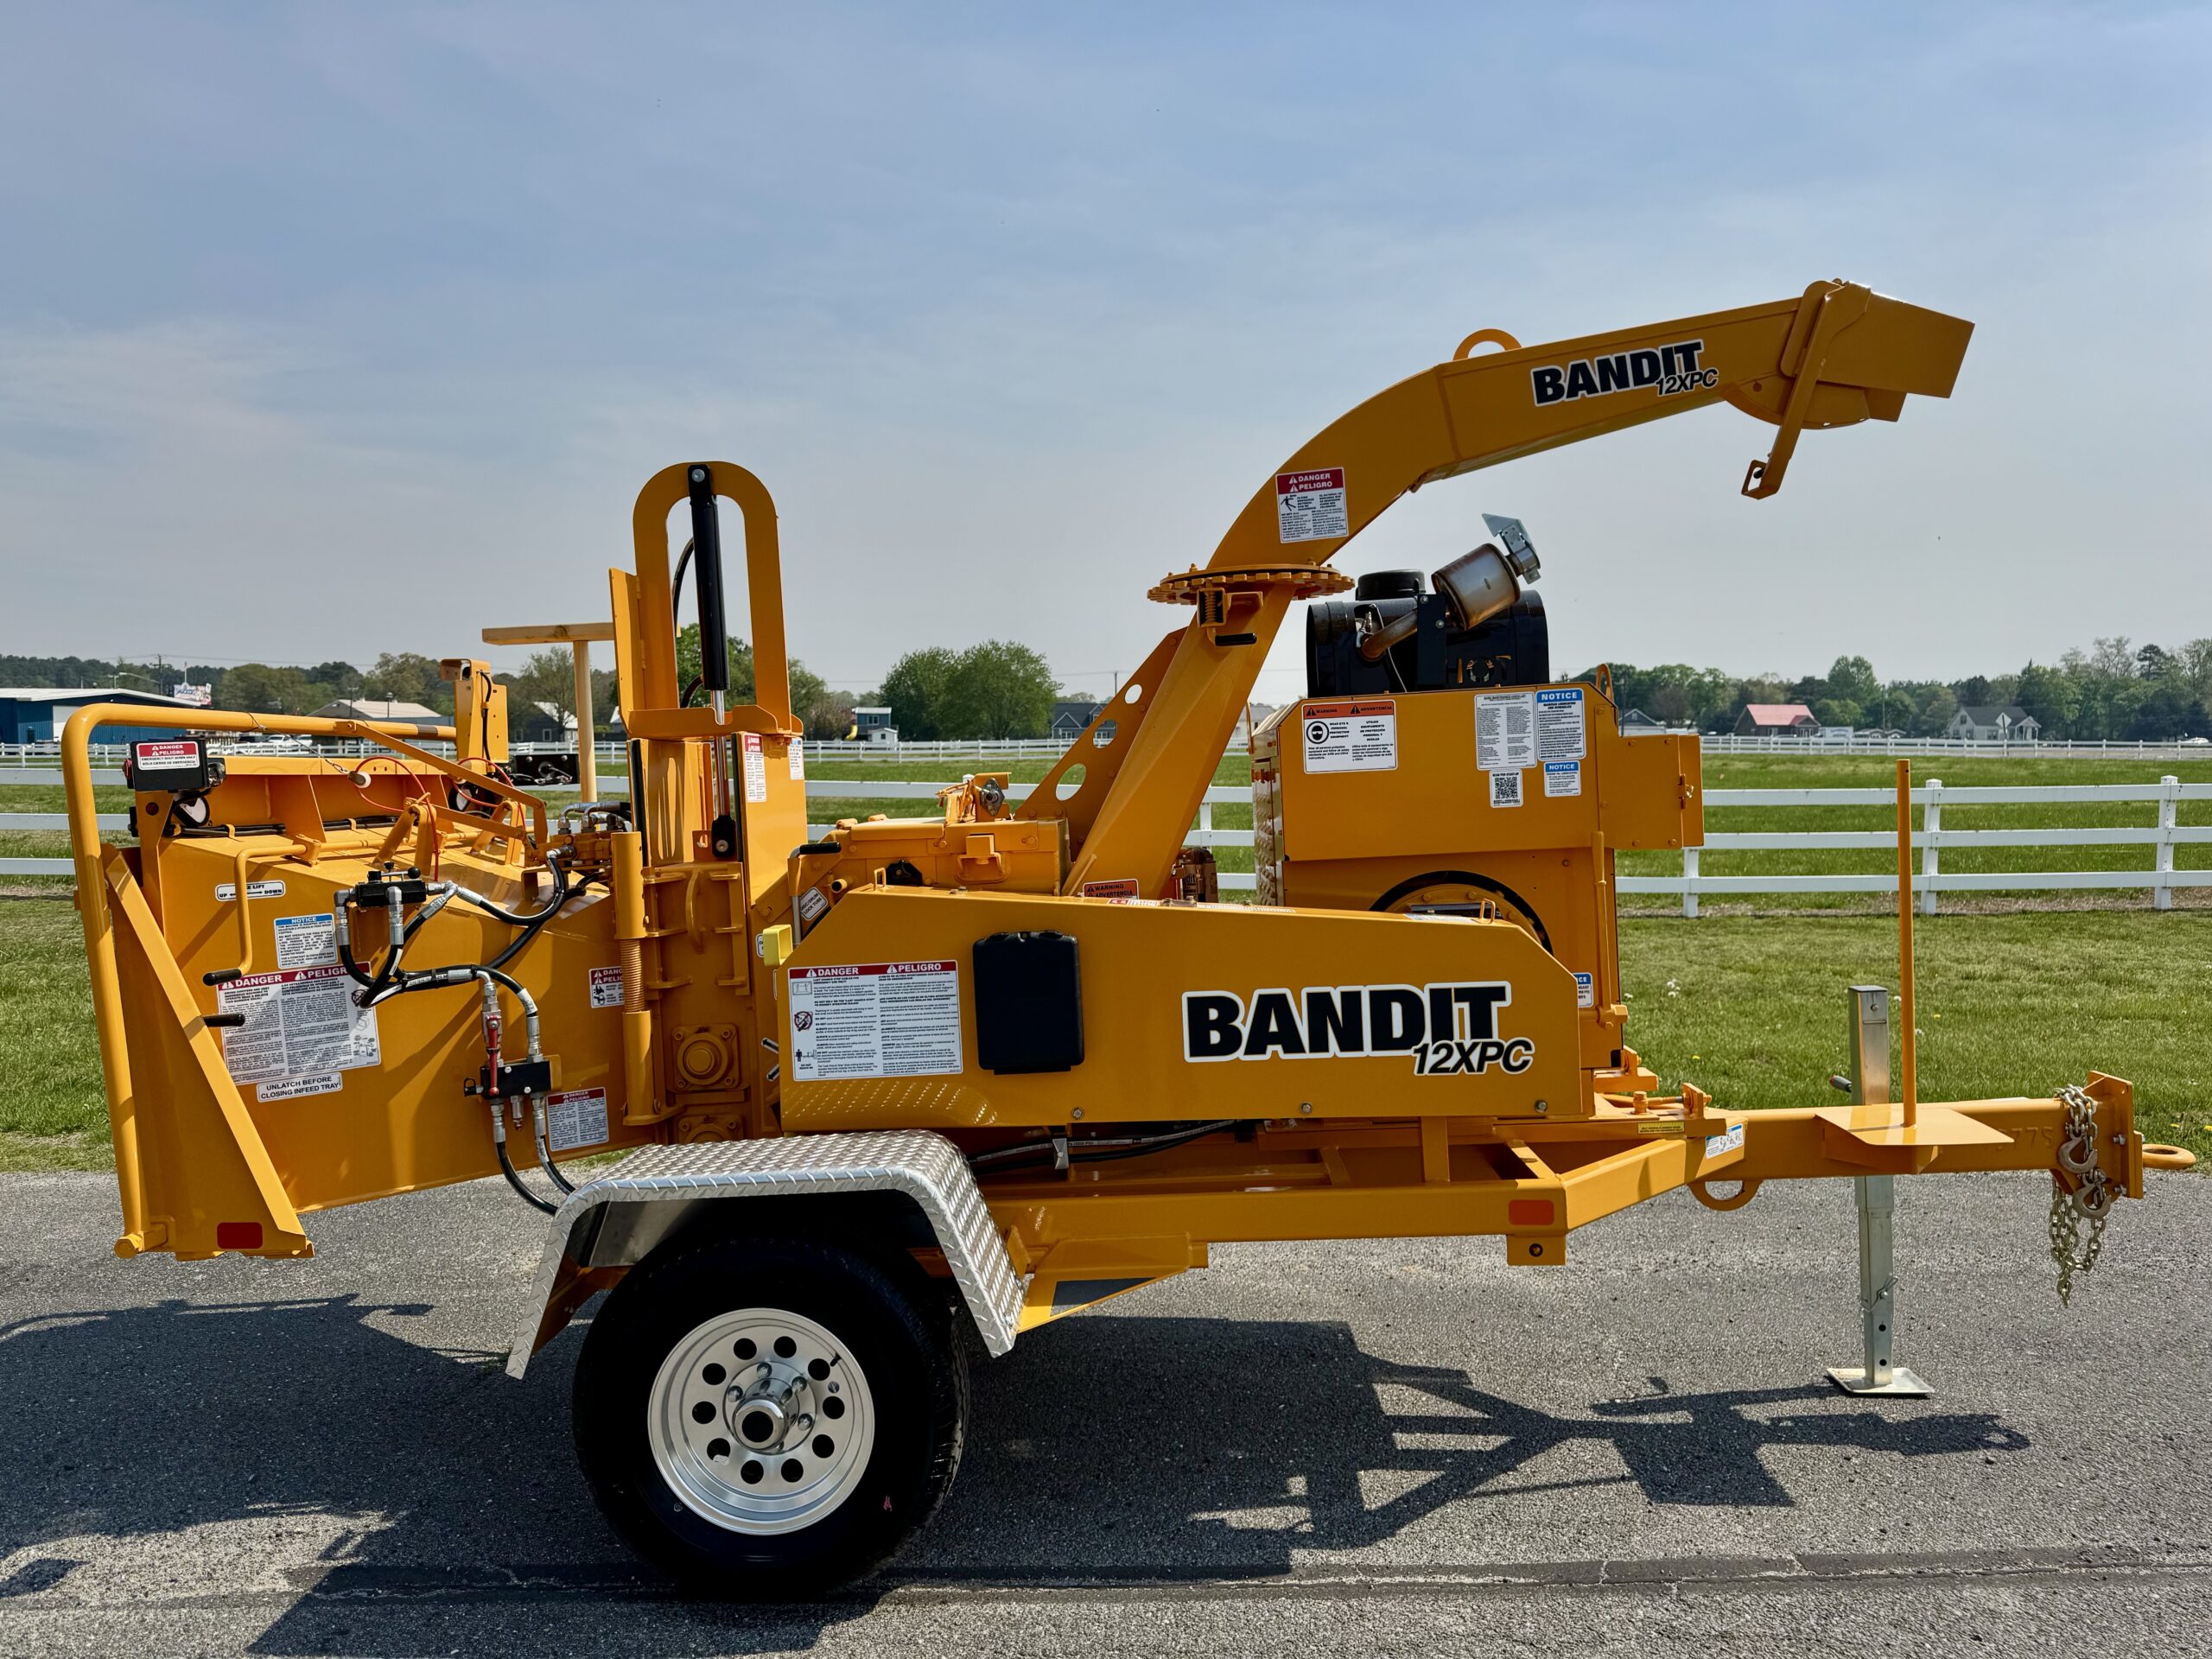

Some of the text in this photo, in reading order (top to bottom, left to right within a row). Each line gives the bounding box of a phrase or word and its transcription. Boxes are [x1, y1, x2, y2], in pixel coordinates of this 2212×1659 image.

[1532, 341, 1702, 405] BANDIT
[1656, 369, 1718, 396] 12XPC
[1300, 481, 1332, 490] PELIGRO
[308, 968, 347, 978] PELIGR
[817, 968, 859, 976] DANGER
[899, 963, 941, 972] PELIGRO
[235, 975, 283, 987] DANGER
[1186, 985, 1507, 1058] BANDIT
[1413, 1039, 1533, 1074] 12XPC
[266, 1076, 332, 1090] UNLATCH BEFORE
[261, 1083, 340, 1099] CLOSING INFEED TRAY
